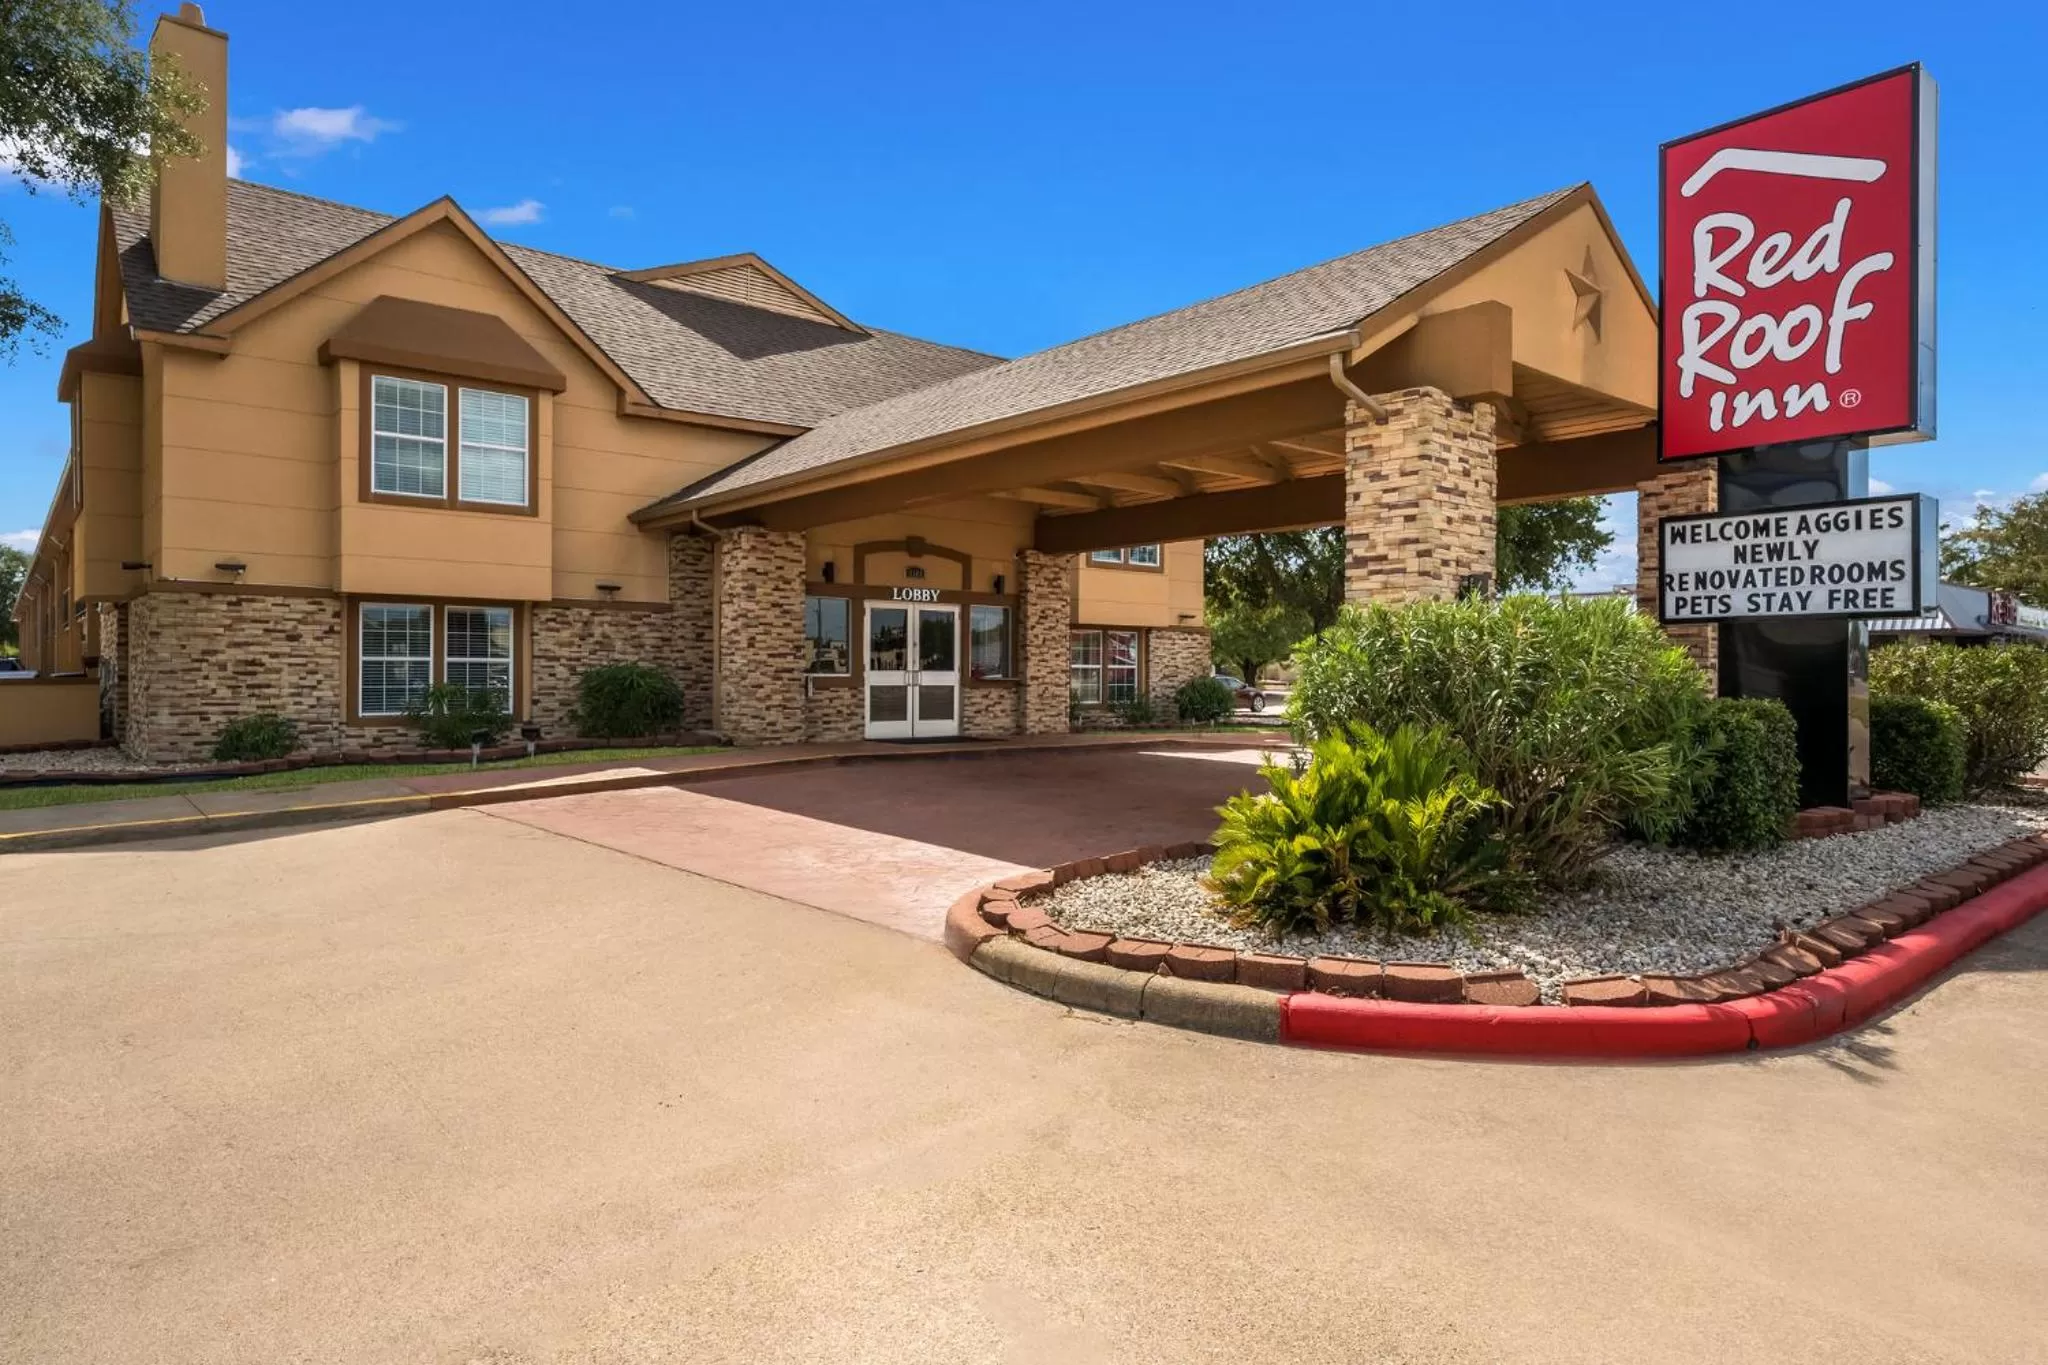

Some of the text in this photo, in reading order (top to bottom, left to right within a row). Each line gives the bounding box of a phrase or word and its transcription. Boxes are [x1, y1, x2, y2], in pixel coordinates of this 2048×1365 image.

[1693, 198, 1851, 298] Red
[1676, 252, 1894, 398] Roof
[1670, 506, 1904, 545] WELCOME AGGIES
[1733, 539, 1820, 565] NEWLY
[1664, 559, 1906, 592] RENOVATED ROOMS
[892, 587, 941, 602] LOBBY
[1674, 587, 1896, 616] PETS STAY FREE
